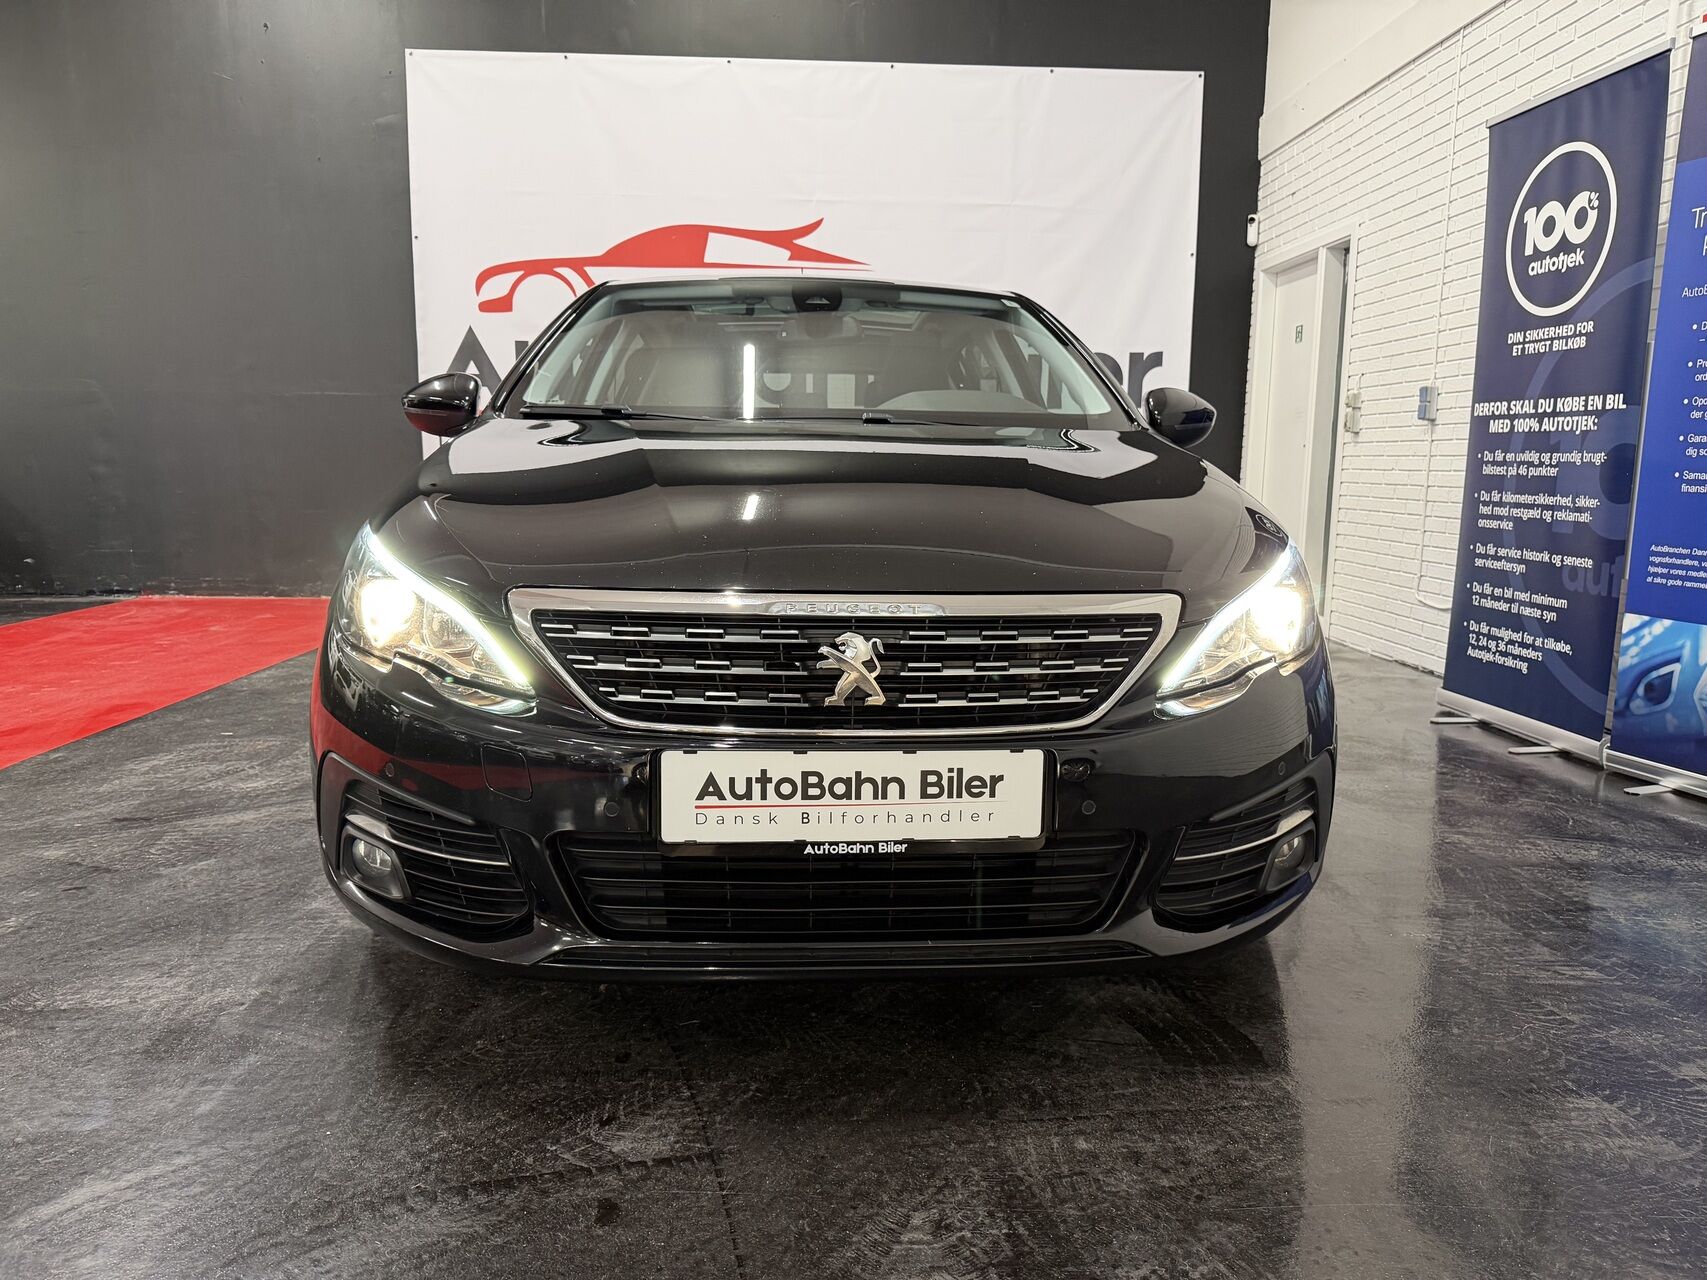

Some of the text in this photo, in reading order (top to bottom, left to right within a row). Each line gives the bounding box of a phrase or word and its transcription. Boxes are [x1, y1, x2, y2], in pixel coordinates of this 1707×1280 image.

[1528, 248, 1584, 276] autotjek
[1508, 321, 1594, 344] DIN SIKKERHED FOR
[1512, 336, 1586, 356] ET TRYGT BILKØB
[1474, 394, 1626, 416] DERFOR SKAL DU KØBE EN BIL
[1489, 415, 1598, 434] MED 100% AUTOTJEK:
[1483, 450, 1607, 466] Du får en uvildig og grundig brugt-
[1483, 463, 1558, 478] bilstest på 46 punkter
[1481, 490, 1600, 508] Du får kilometersikkerhed, sikker-
[1479, 504, 1592, 522] hed mod restgæld og reklamati-
[1478, 519, 1513, 530] onsservice
[1476, 543, 1592, 568] Du får service historik og seneste
[1475, 558, 1525, 575] serviceeftersyn
[1473, 582, 1567, 609] Du får en bil med minimum
[786, 603, 921, 614] PEUGEOT
[1472, 595, 1479, 606] 12
[1481, 597, 1510, 611] måneder
[1520, 605, 1541, 619] næste
[1543, 611, 1556, 623] syn
[1469, 634, 1542, 662] 12, 24 og 36 måneders
[1470, 620, 1573, 656] Du får mulighed for at tilkøbe,
[1467, 646, 1528, 675] Autotjek-forsikring
[695, 768, 1004, 801] AutoBahn Biler
[695, 810, 994, 825] Dansk Bilforhandler
[804, 842, 907, 855] AutoBahn Biler
